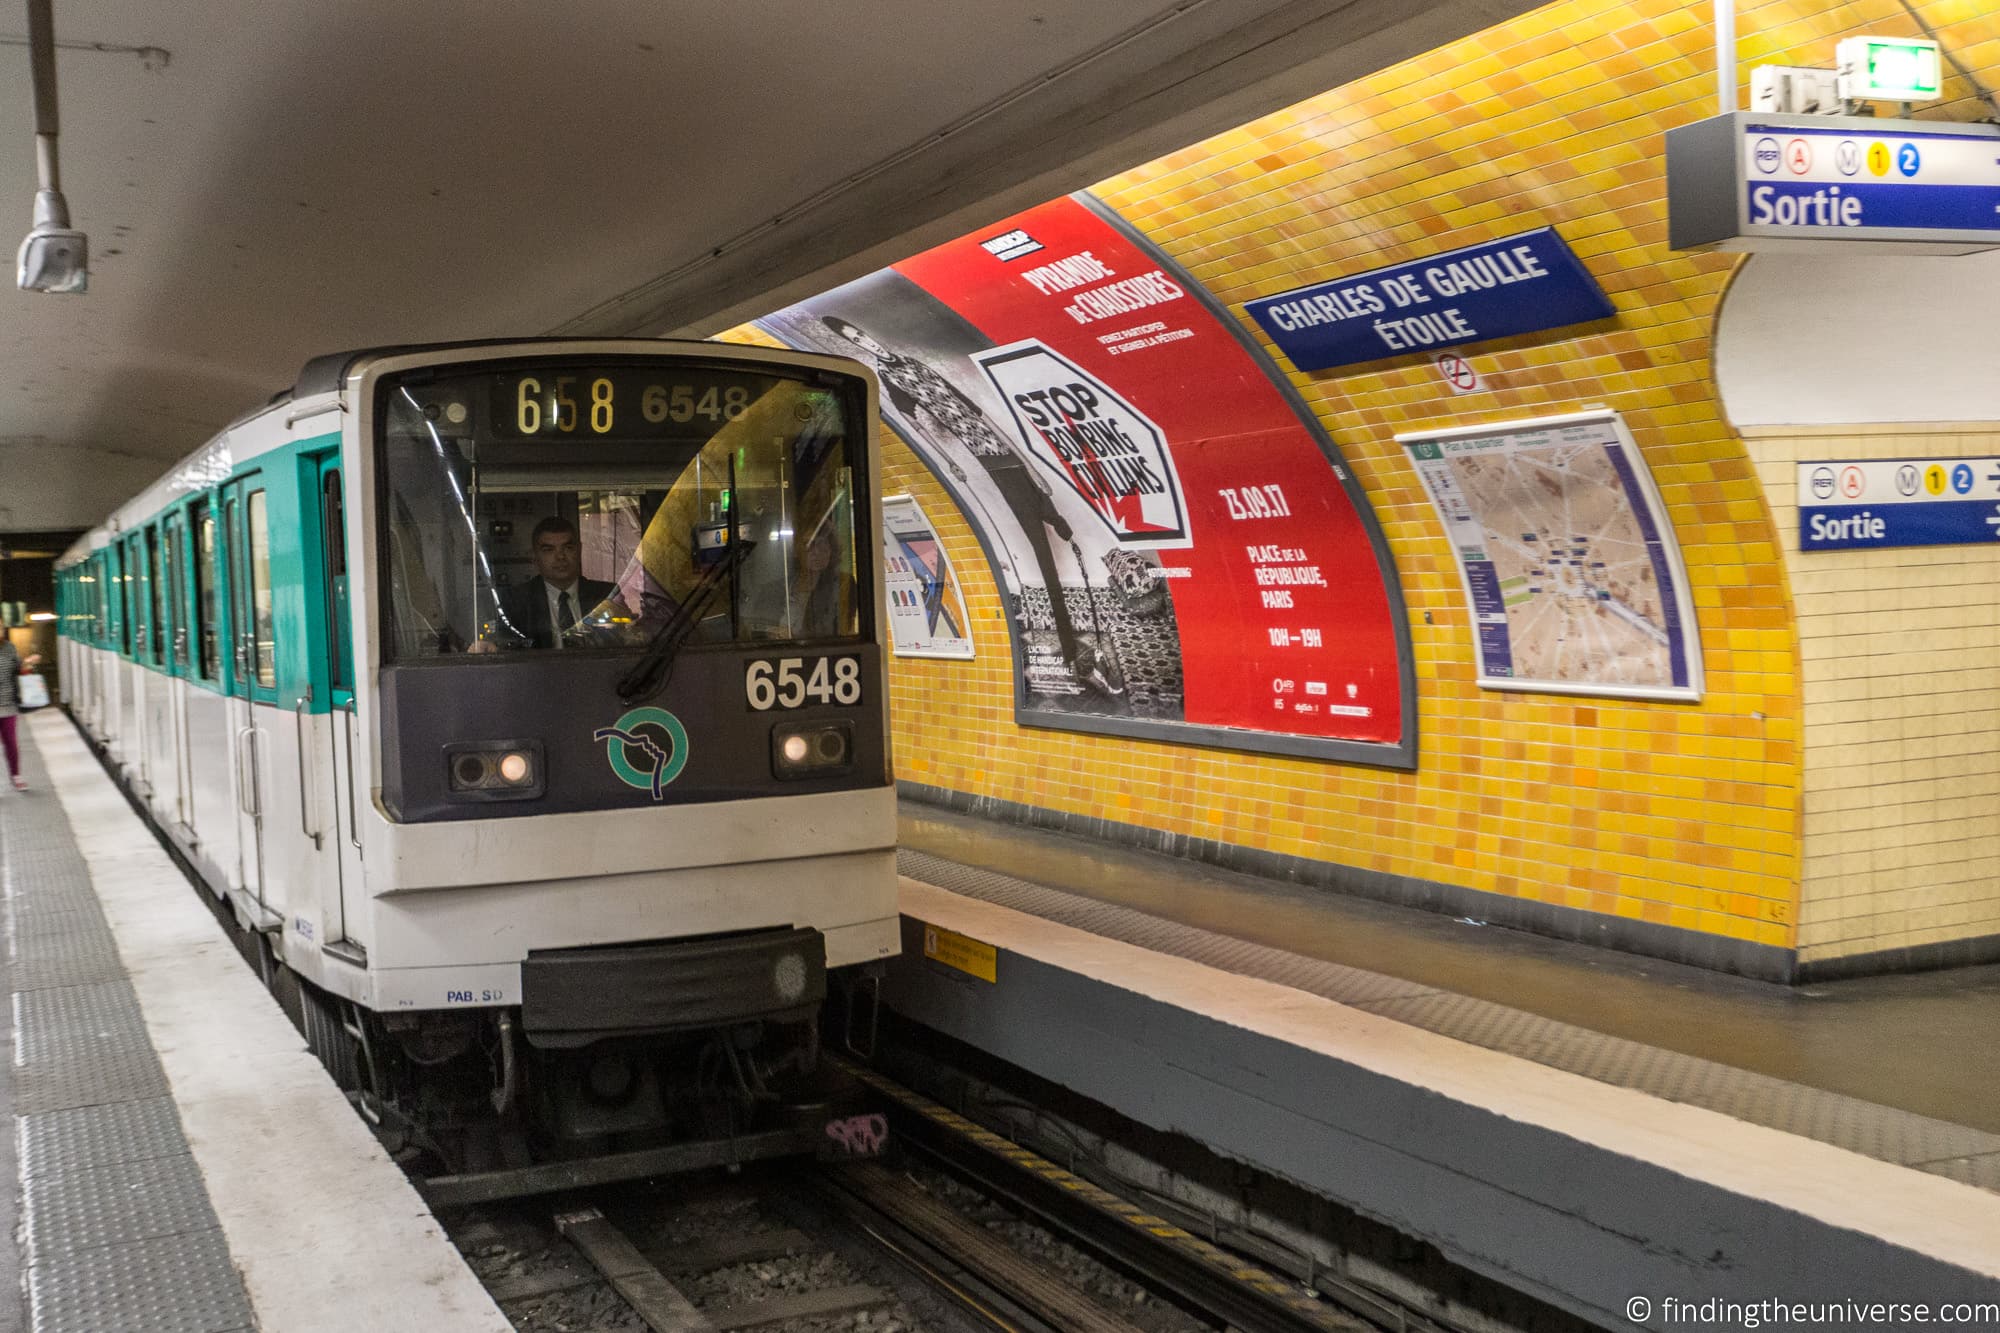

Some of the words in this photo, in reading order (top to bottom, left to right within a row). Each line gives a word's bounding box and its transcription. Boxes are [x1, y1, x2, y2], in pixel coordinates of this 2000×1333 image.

[1902, 150, 1916, 170] 2
[1753, 186, 1862, 227] Sortie
[1020, 250, 1116, 296] PYRAMIDE
[1268, 284, 1386, 332] CHARLES
[1380, 274, 1431, 309] DE
[1427, 245, 1549, 296] GAULLE
[1073, 270, 1184, 320] CHAUSSURES
[1064, 304, 1093, 325] DE
[1373, 308, 1476, 350] ÉTOILE
[642, 385, 748, 422] 6548
[1014, 383, 1100, 427] STOP
[1041, 418, 1139, 463] BOMBING
[1071, 456, 1165, 499] CIVILIANS
[1957, 470, 1969, 488] 2
[1218, 484, 1291, 520] 23.09.17
[1810, 512, 1886, 541] Sortie
[1246, 545, 1282, 563] PLACE
[1281, 550, 1295, 561] DE
[1295, 549, 1307, 561] LA
[1254, 565, 1328, 588] RÉPUBLIQUE,
[1261, 590, 1294, 608] PARIS
[746, 657, 862, 711] 6548
[447, 991, 478, 1002] PAB.
